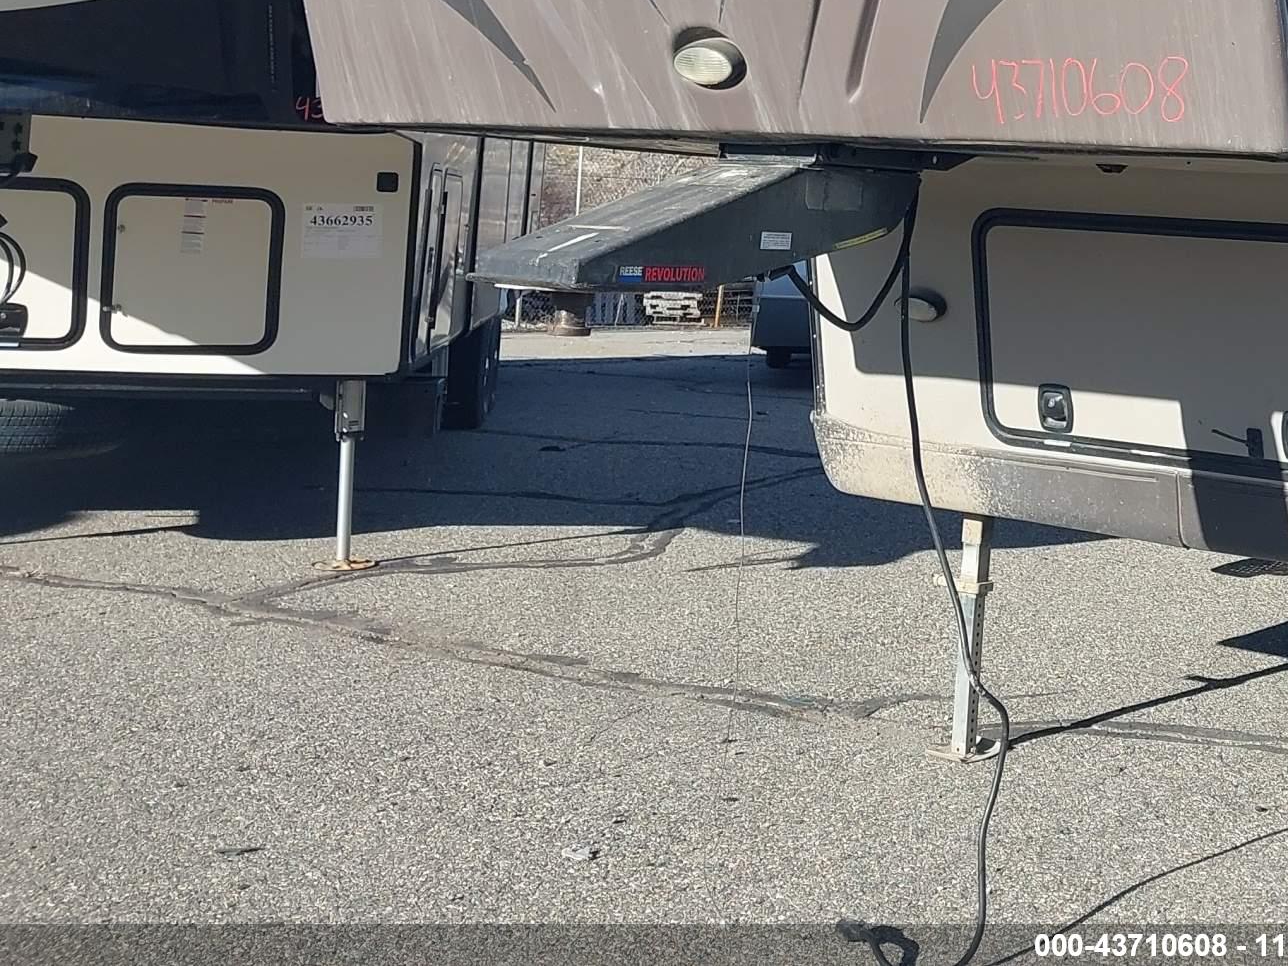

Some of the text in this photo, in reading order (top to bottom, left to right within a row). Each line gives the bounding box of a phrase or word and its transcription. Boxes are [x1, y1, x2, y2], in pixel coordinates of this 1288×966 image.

[971, 55, 1190, 124] 43710608
[309, 215, 373, 226] 43662935
[619, 265, 705, 282] REESE REVOLUTION
